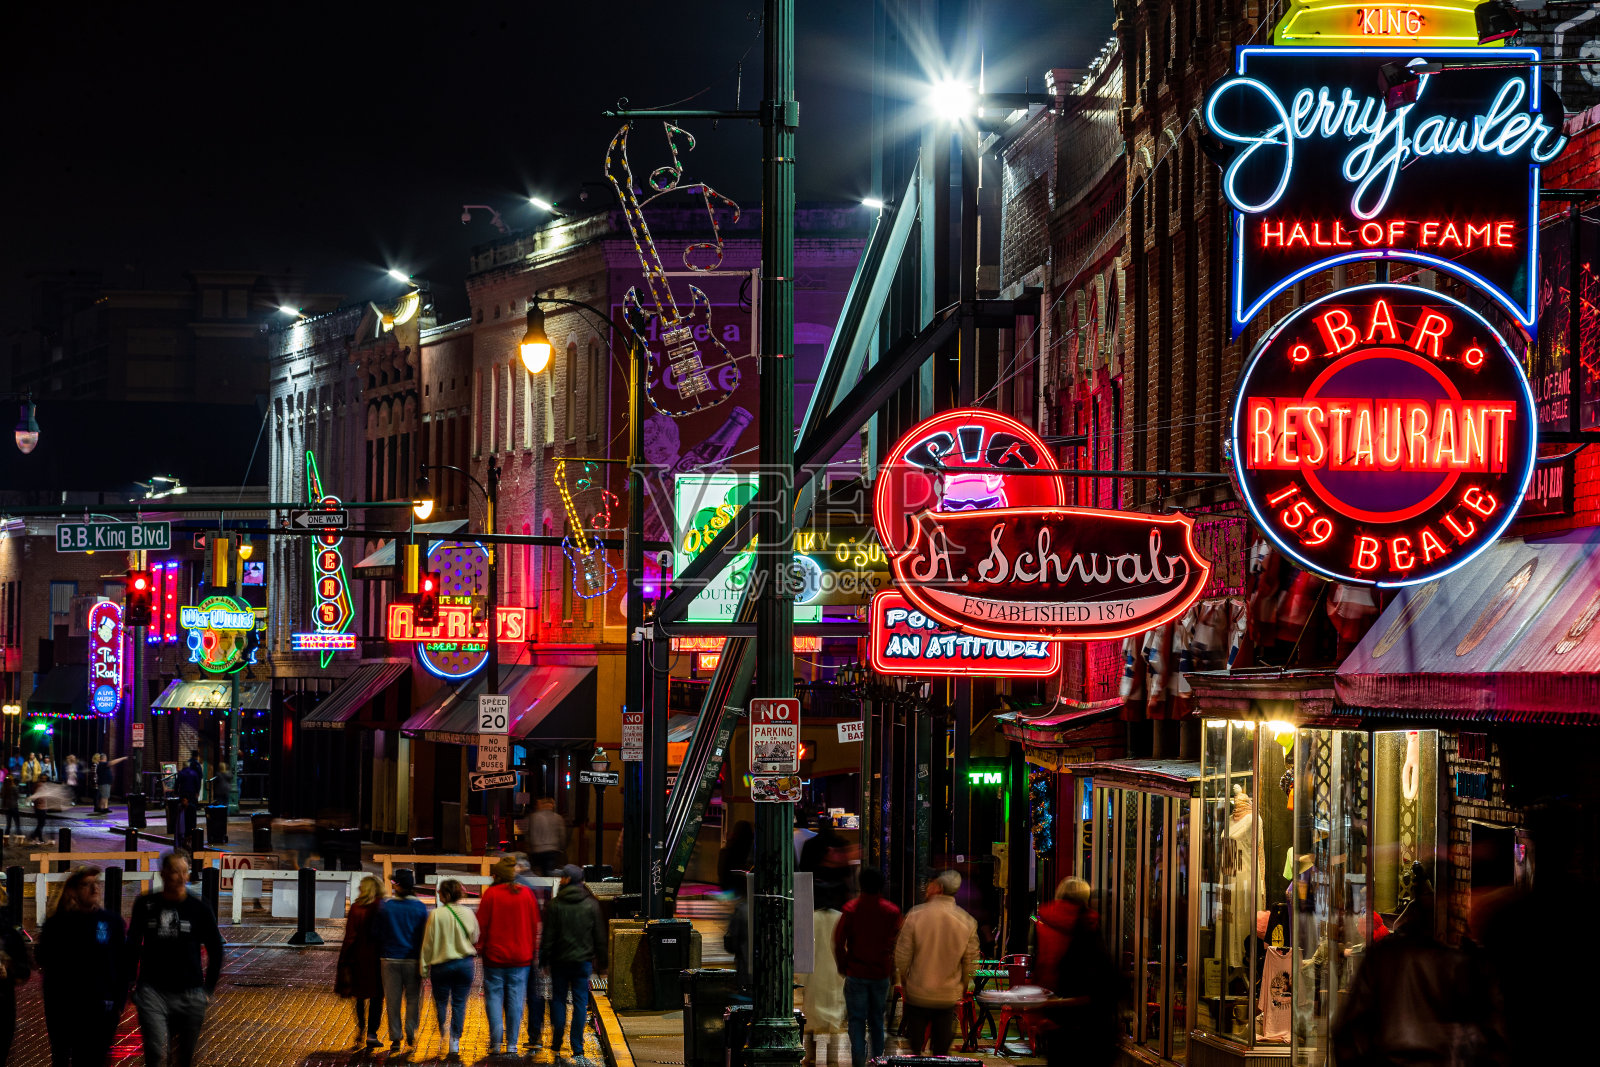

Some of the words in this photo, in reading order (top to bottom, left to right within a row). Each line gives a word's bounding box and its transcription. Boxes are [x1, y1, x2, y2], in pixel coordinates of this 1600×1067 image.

[1361, 9, 1422, 35] KING
[1206, 77, 1390, 212] Jerry
[1263, 222, 1352, 247] HALL
[1361, 222, 1406, 247] OF
[1421, 222, 1515, 247] FAME
[723, 322, 741, 342] a
[1313, 300, 1453, 354] BAR
[1247, 397, 1516, 473] RESTAURANT
[325, 515, 342, 523] WAY
[1266, 481, 1334, 546] 159
[1350, 485, 1498, 571] BEALE
[61, 527, 92, 547] B.B.
[95, 525, 125, 548] King
[131, 525, 168, 546] Blvd.
[911, 525, 968, 583] A.
[978, 523, 1190, 585] Schwab
[455, 596, 471, 605] MU
[962, 598, 1091, 622] ESTABLISHED
[1098, 601, 1135, 621] 1876
[887, 609, 939, 628] PO
[97, 647, 116, 663] Tin
[887, 636, 923, 657] AN
[95, 662, 118, 685] Roof
[481, 714, 506, 729] 20
[626, 714, 641, 723] NO
[760, 703, 790, 720] NO
[755, 726, 793, 737] PARKING
